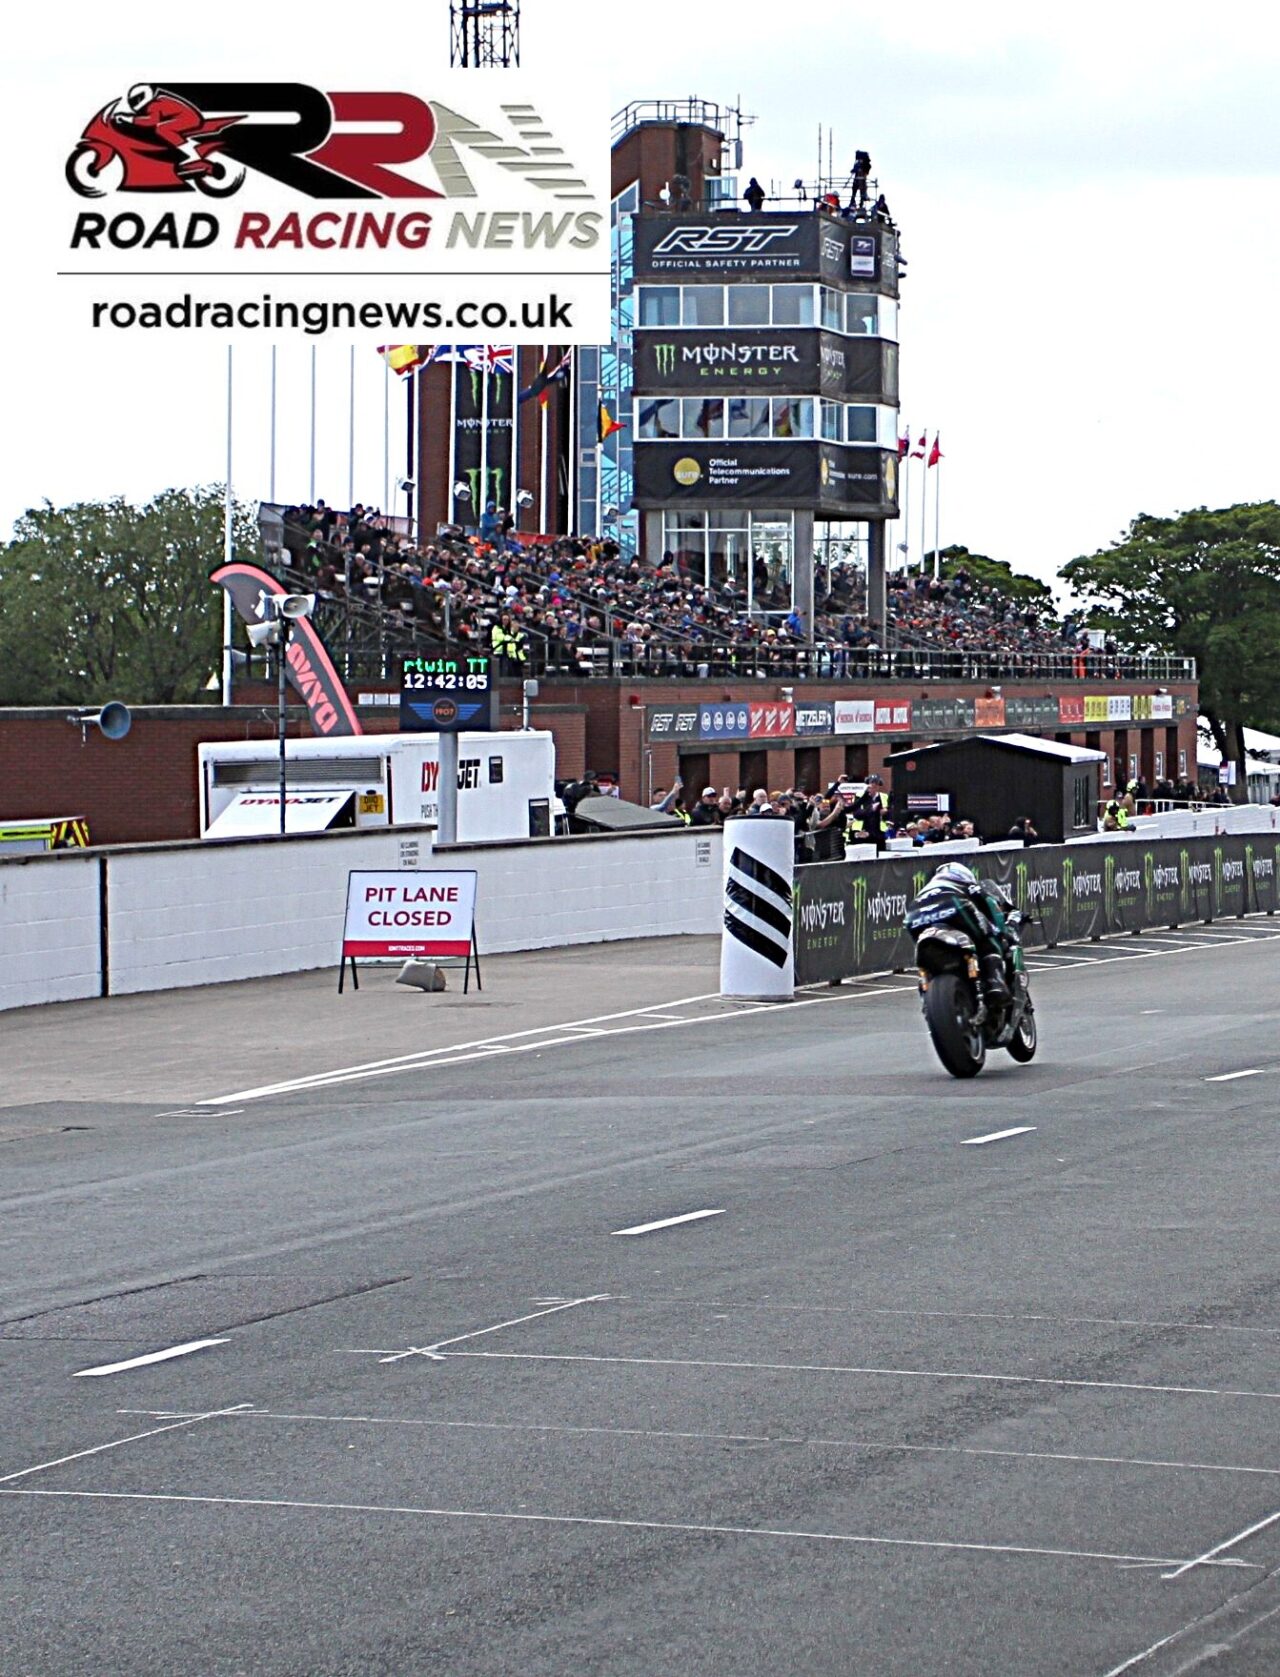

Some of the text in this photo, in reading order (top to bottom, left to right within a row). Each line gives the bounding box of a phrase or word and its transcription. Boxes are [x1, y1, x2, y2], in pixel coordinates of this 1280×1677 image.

[652, 225, 799, 252] RST
[651, 259, 800, 268] OFFICIAL SAFETY PARTNER
[682, 342, 800, 365] MONSTER
[700, 367, 783, 376] ENERGY
[709, 476, 739, 484] Partner
[404, 658, 488, 673] rtwin TT
[404, 673, 488, 689] 12:42:05
[366, 887, 458, 902] PIT LANE
[801, 898, 845, 932] MONSTER
[867, 891, 907, 924] MONSTER
[368, 911, 452, 926] CLOSED
